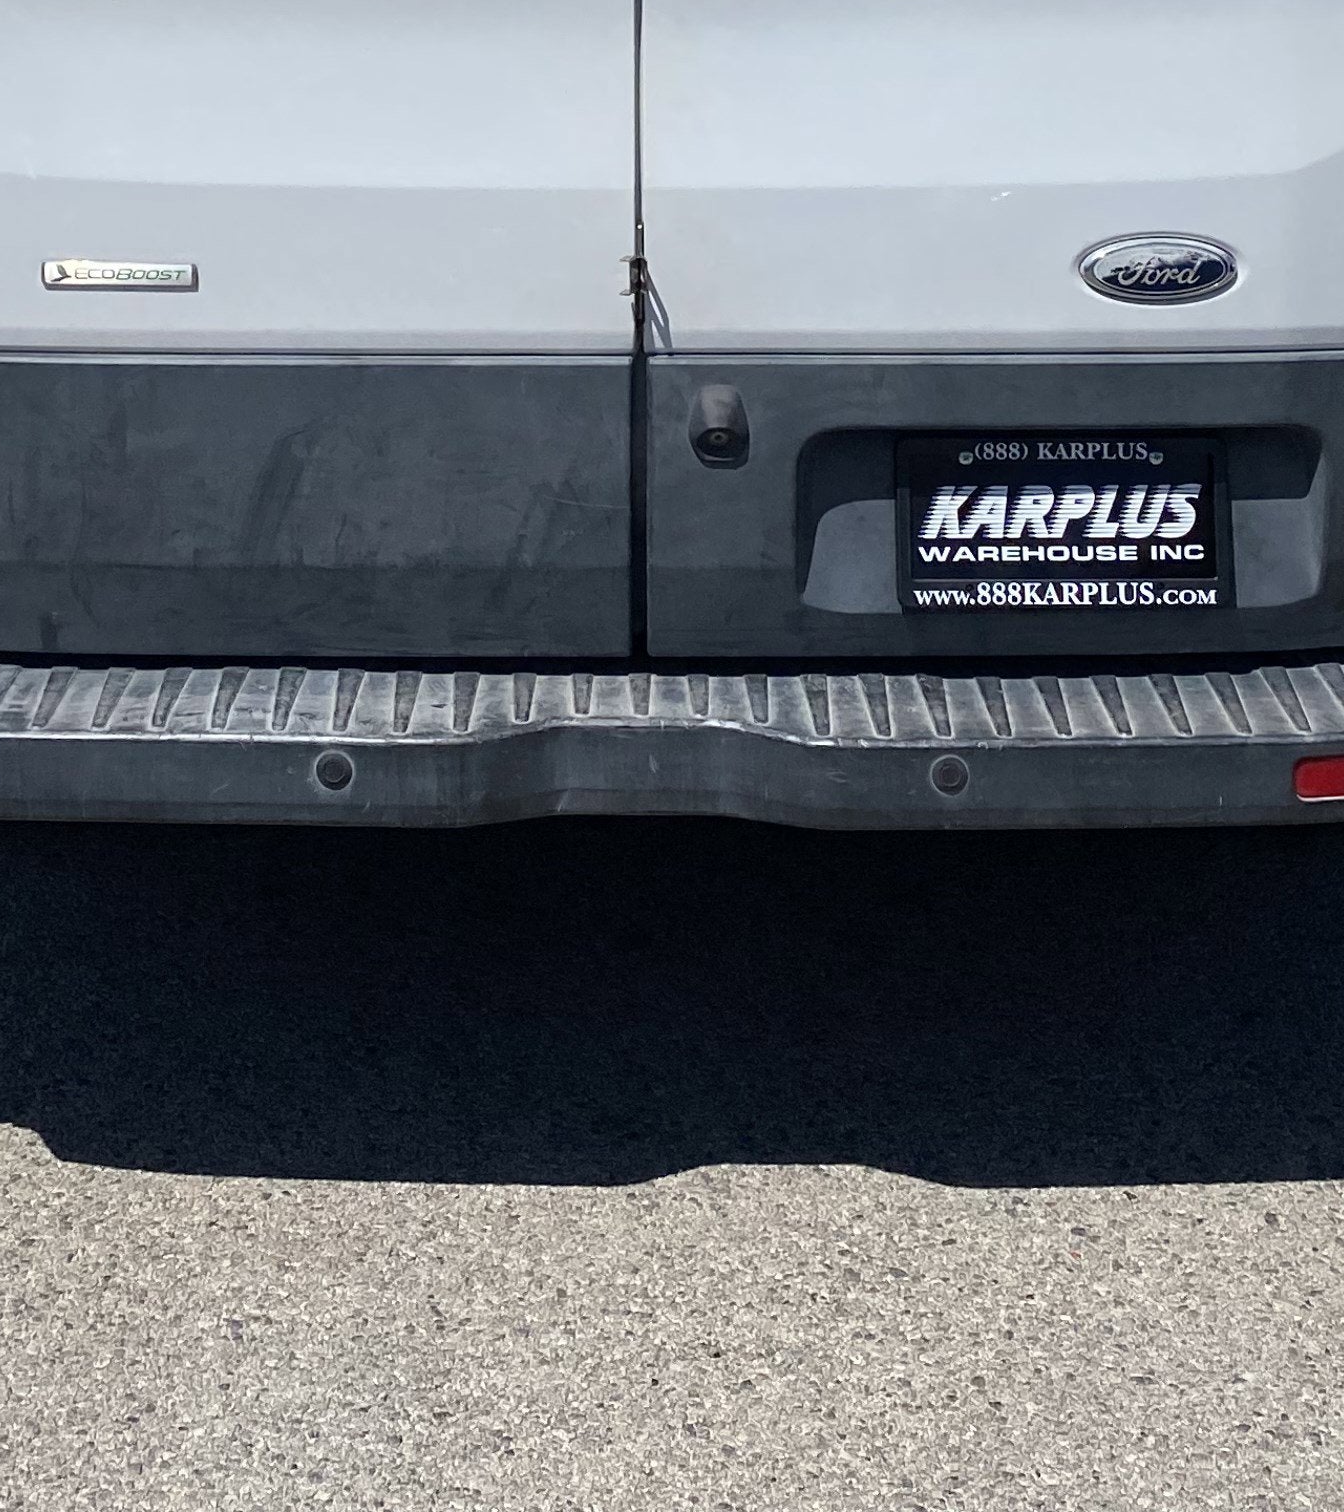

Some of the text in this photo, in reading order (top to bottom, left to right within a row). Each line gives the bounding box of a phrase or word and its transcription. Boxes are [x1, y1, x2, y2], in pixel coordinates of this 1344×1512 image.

[74, 268, 187, 281] ECOBOOST
[1112, 256, 1205, 286] Ford
[974, 442, 1148, 461] (888) KARPLUS
[917, 483, 1203, 539] KARPLUS
[918, 544, 1205, 562] WAREHOUSE INC
